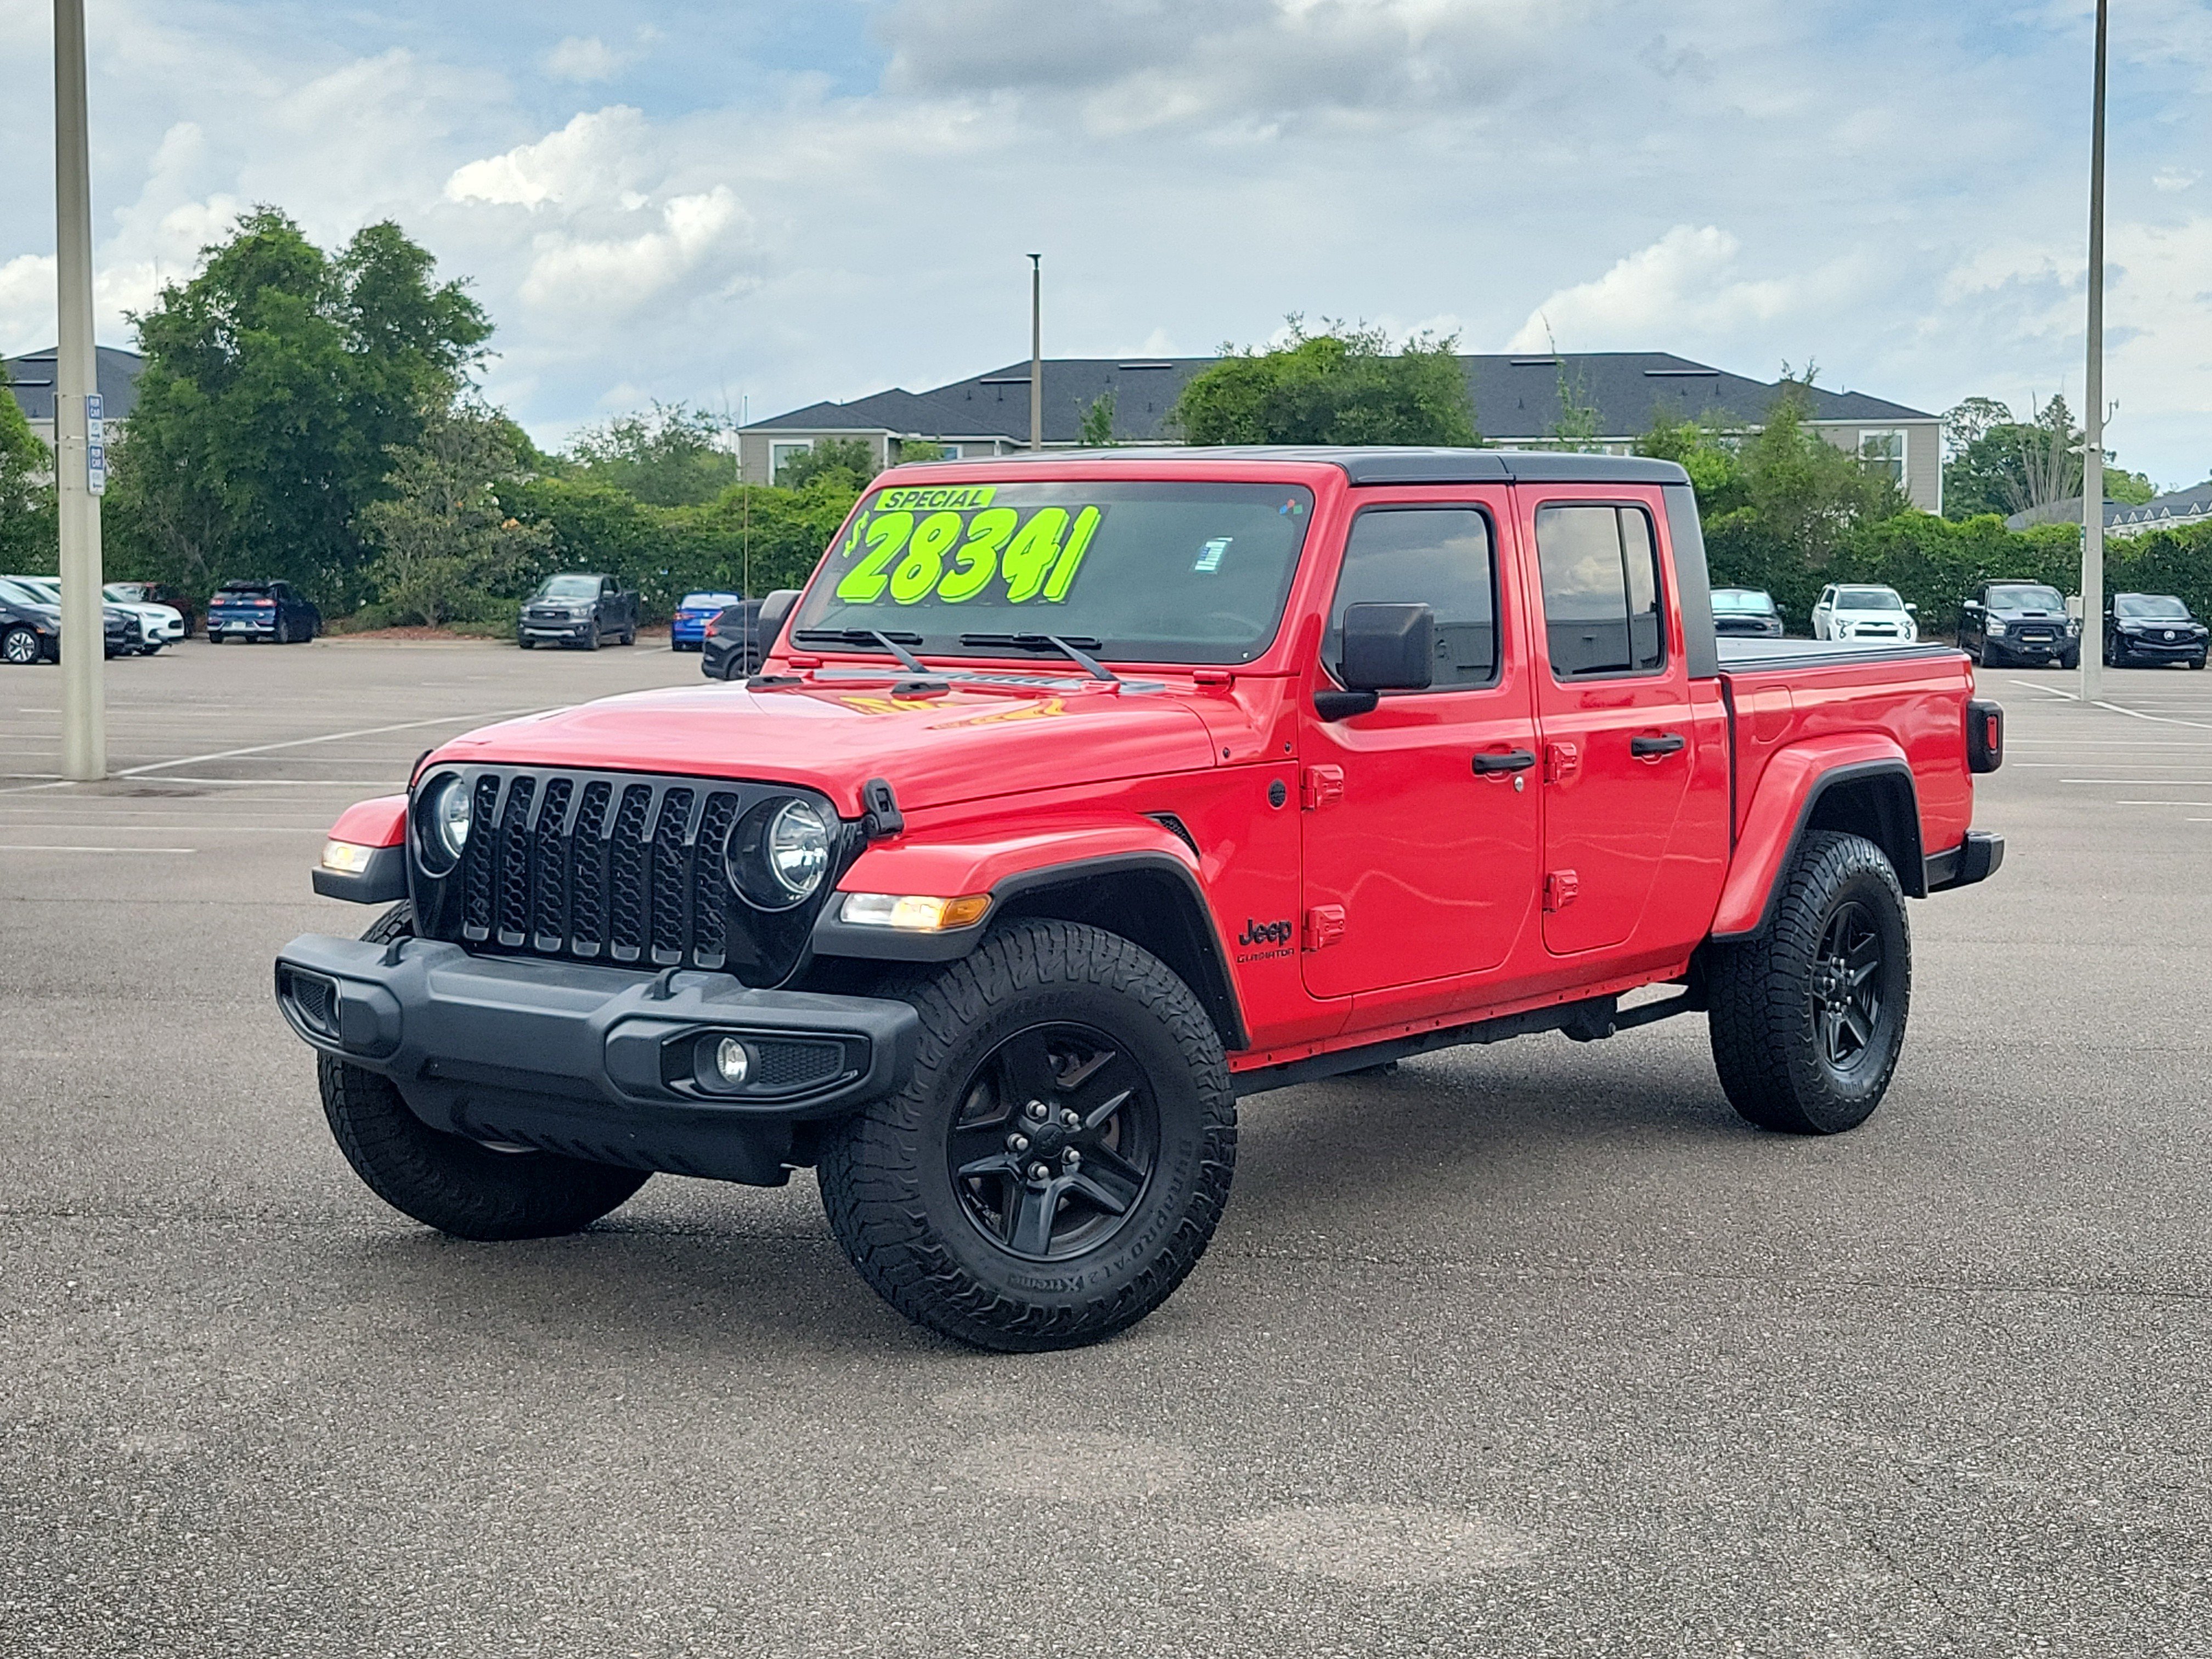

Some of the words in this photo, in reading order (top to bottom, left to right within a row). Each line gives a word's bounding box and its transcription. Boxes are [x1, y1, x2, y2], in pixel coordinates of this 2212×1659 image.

[884, 489, 984, 508] SPECIAL
[1238, 918, 1292, 946] Jeep
[1237, 947, 1295, 963] GLADIATOR
